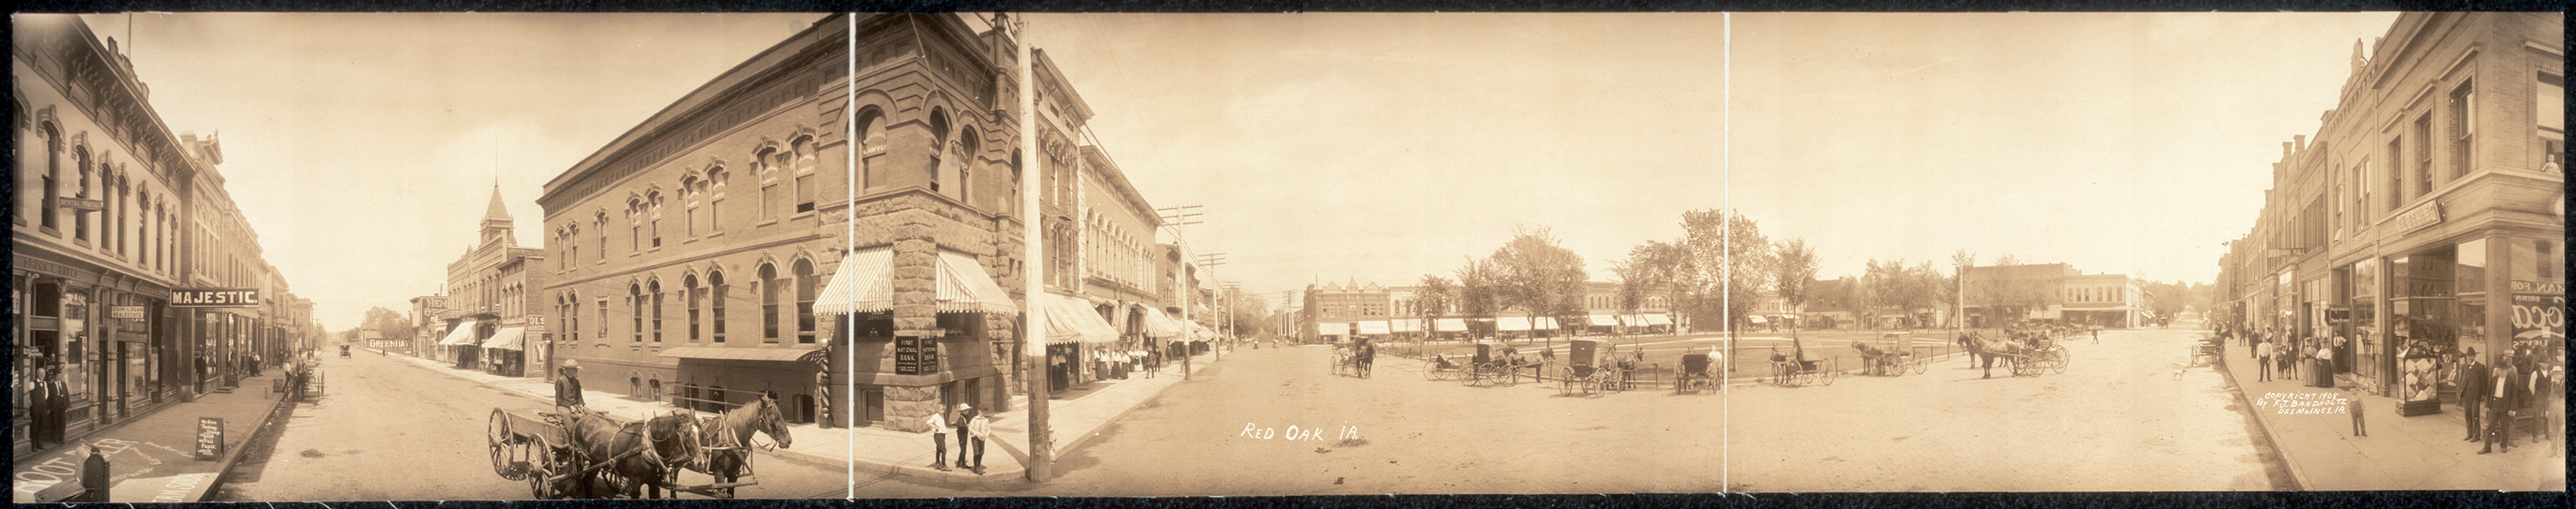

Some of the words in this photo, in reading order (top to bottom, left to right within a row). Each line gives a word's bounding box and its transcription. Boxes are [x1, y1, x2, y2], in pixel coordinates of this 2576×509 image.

[25, 258, 48, 272] DRUGS
[172, 292, 258, 304] MAJESTIC.
[529, 317, 545, 325] OLS
